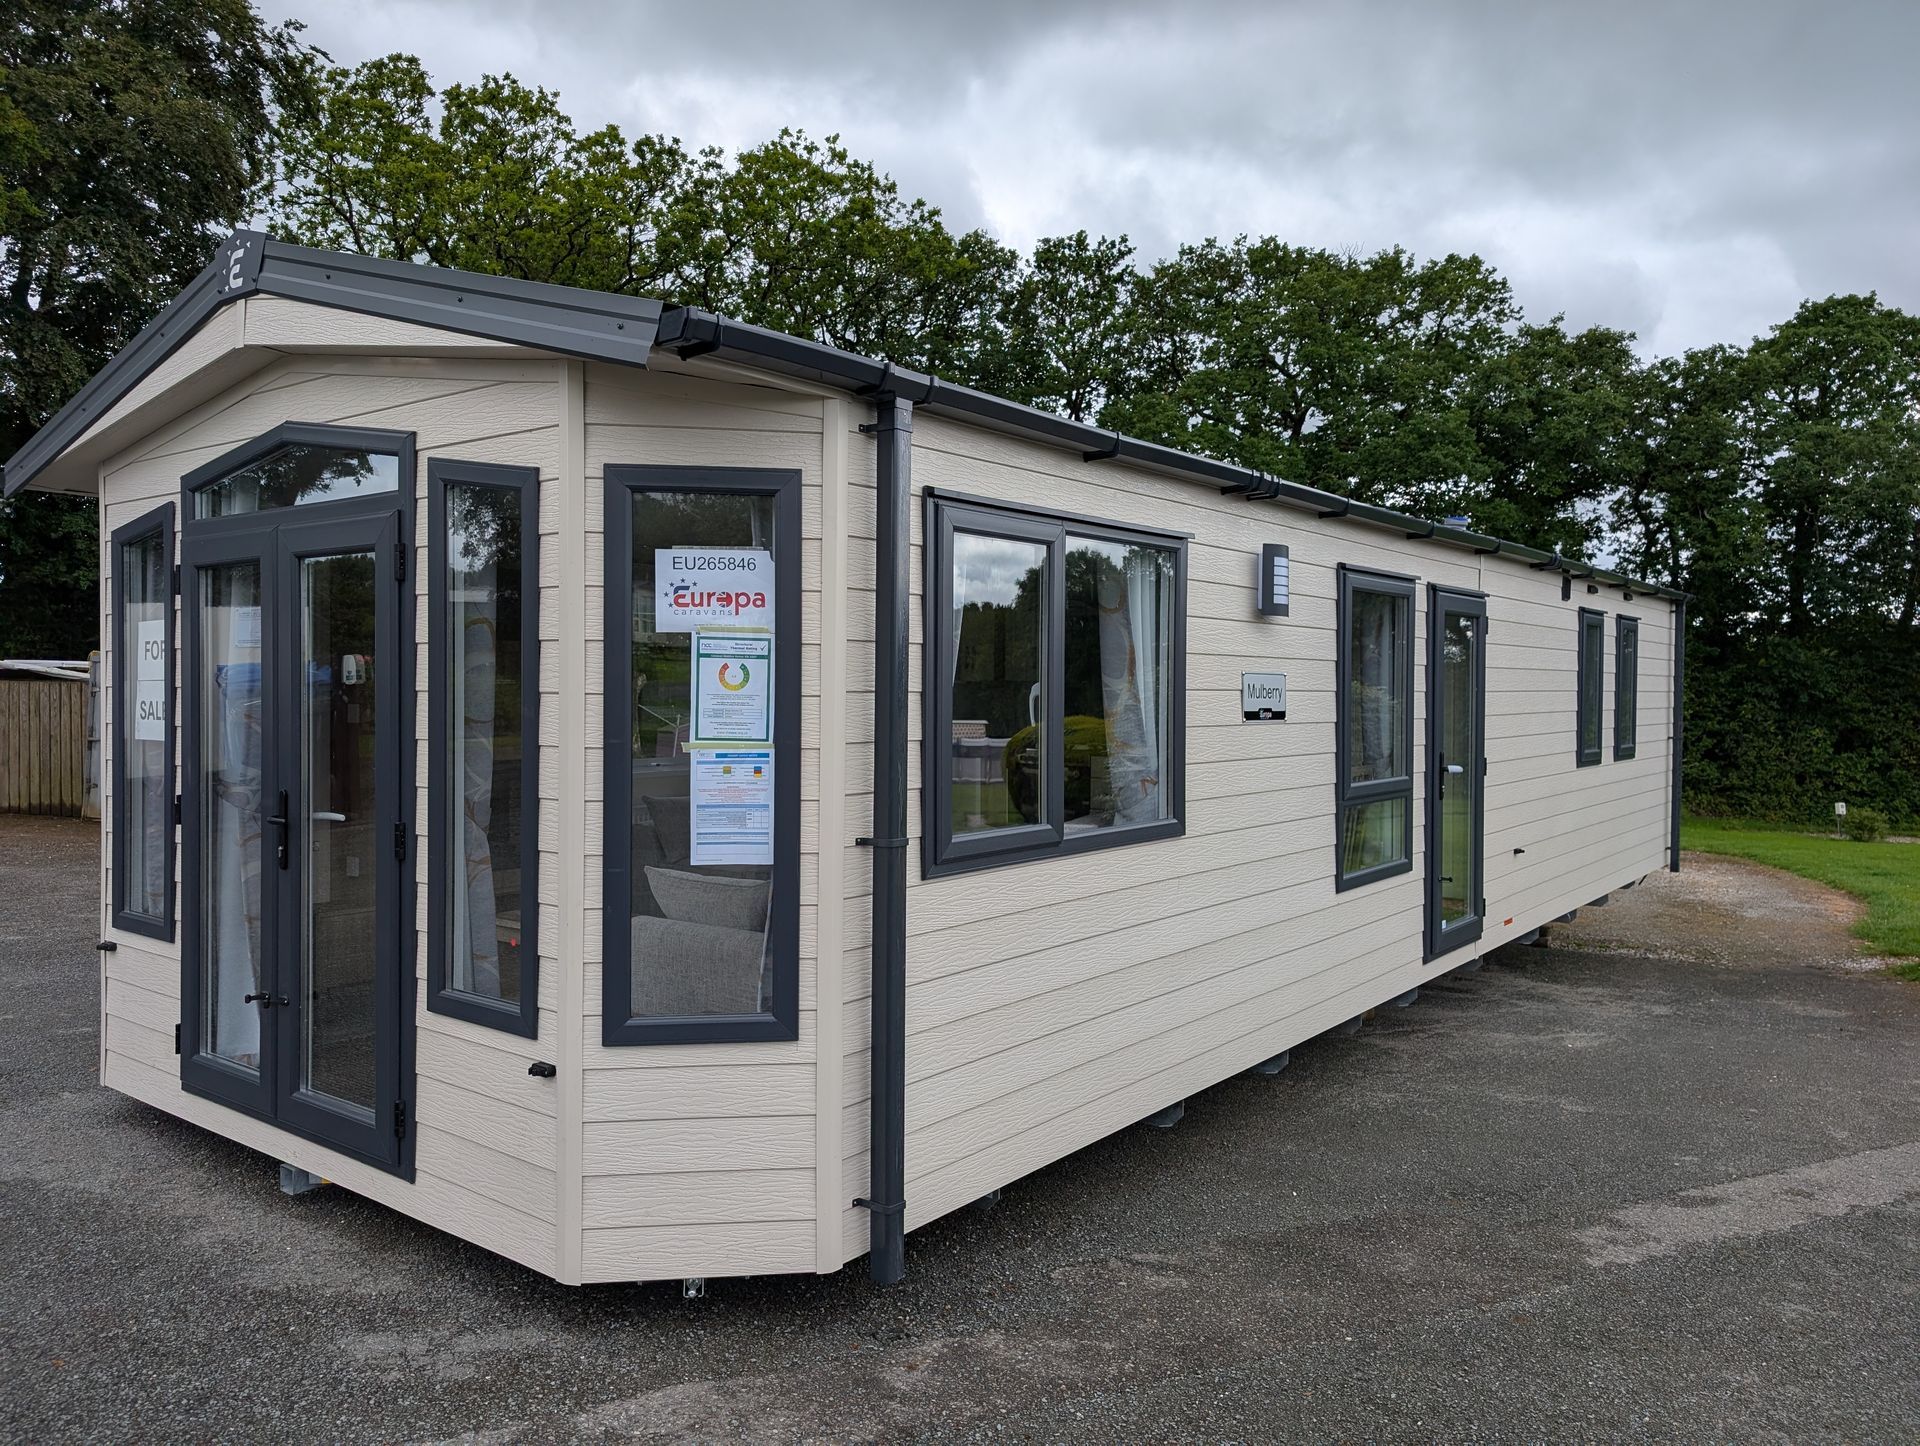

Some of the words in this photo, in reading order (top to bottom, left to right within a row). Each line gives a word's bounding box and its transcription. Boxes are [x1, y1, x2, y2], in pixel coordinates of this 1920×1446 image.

[672, 556, 757, 572] EU265846
[673, 585, 766, 616] Europa
[673, 608, 733, 616] caravans
[1247, 683, 1282, 703] Mulberry
